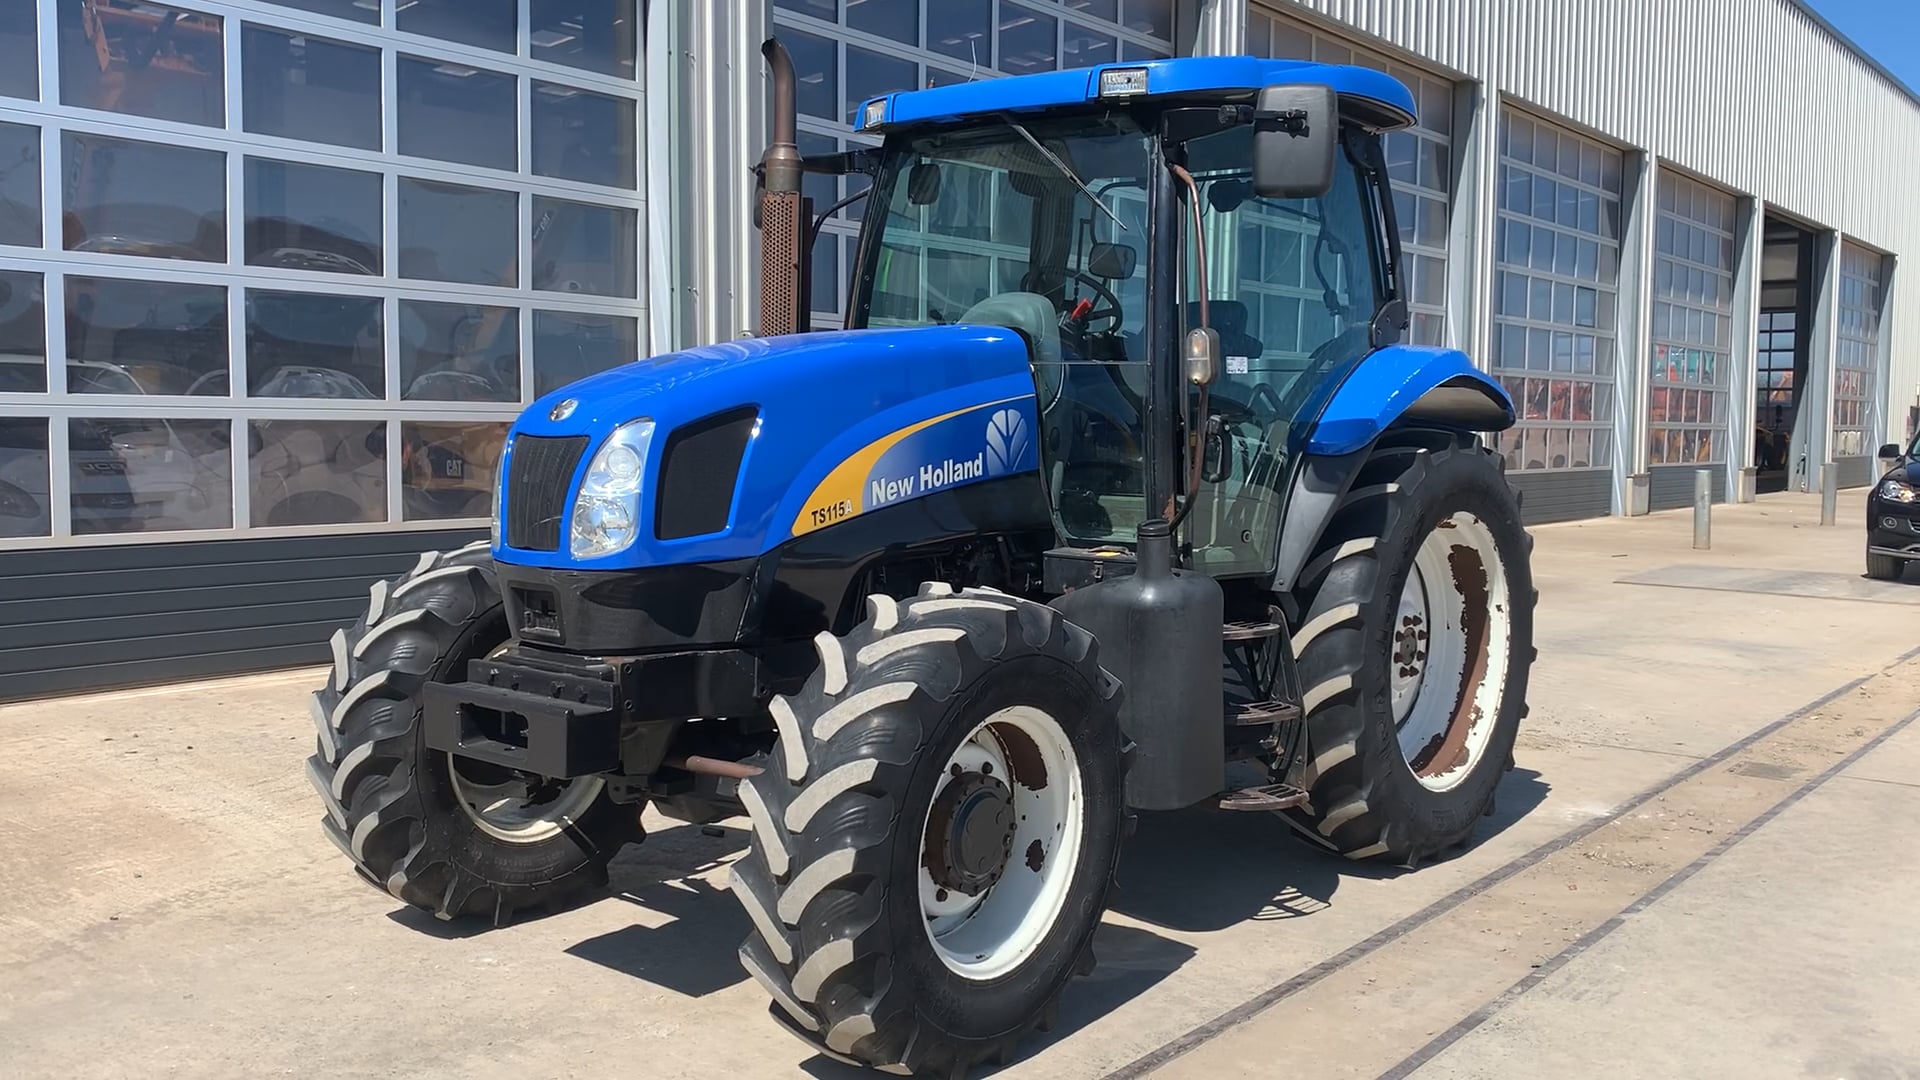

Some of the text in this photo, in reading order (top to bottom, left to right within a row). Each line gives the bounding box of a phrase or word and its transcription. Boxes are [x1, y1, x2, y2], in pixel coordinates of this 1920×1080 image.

[446, 459, 462, 476] CAT
[872, 452, 983, 506] New Holland
[811, 500, 852, 526] TS115A
